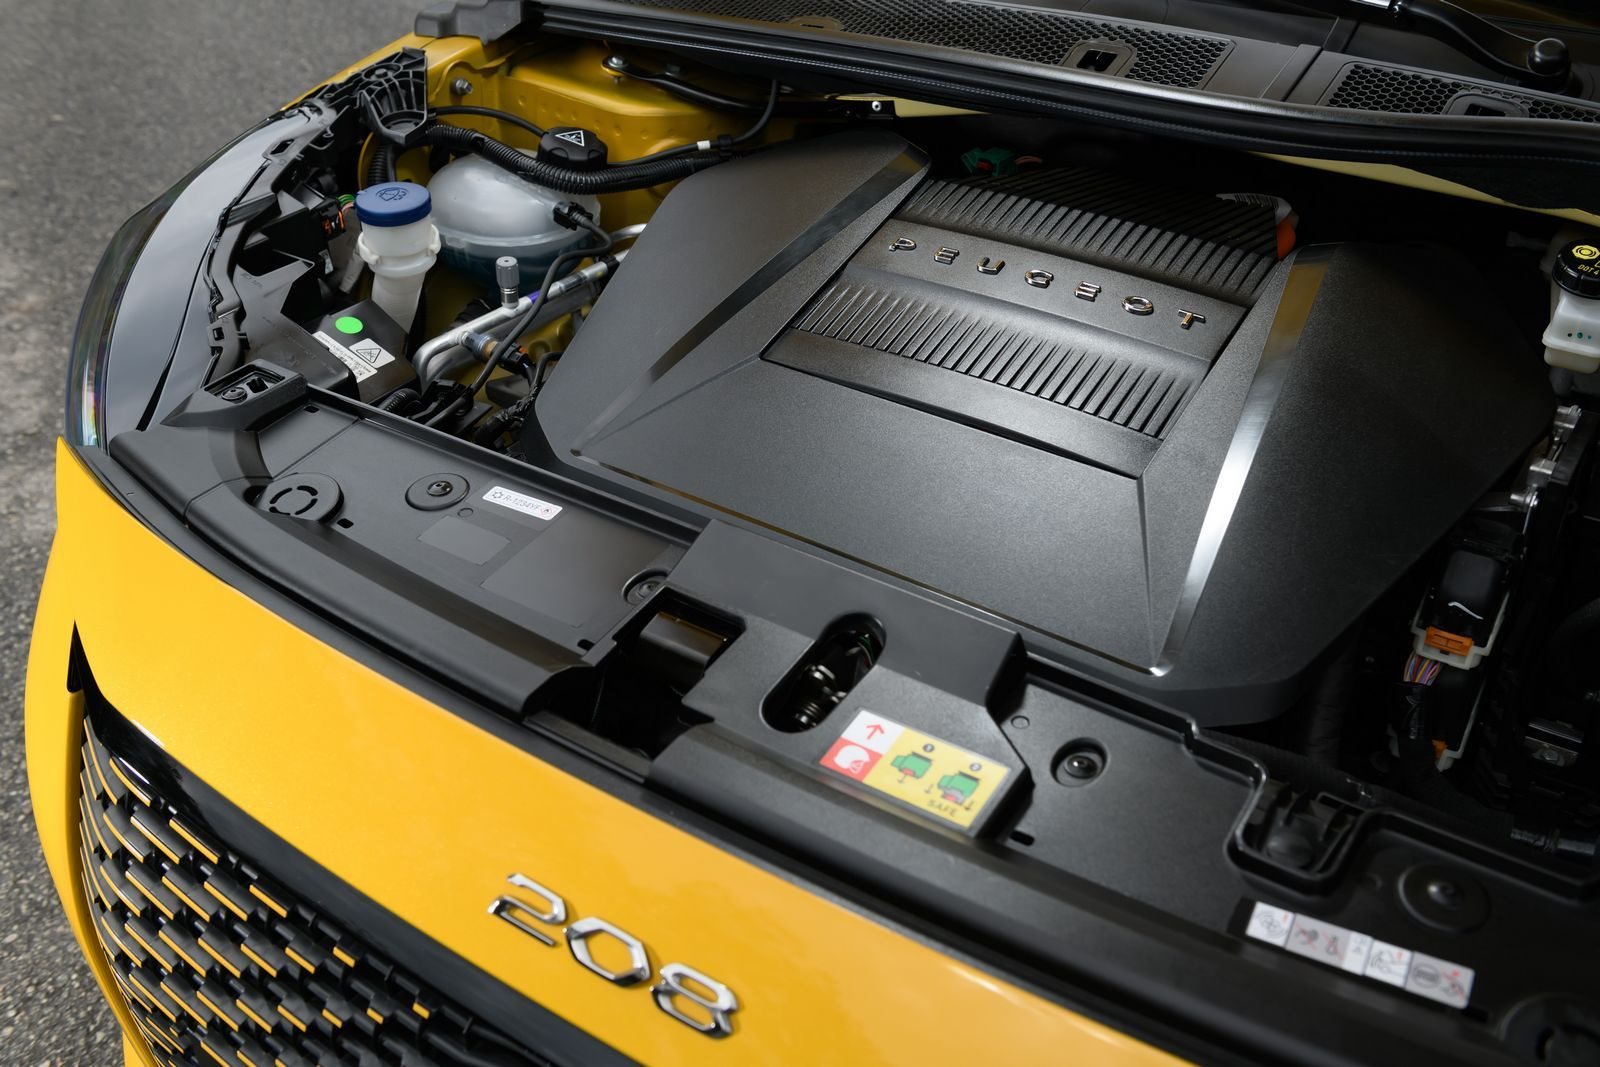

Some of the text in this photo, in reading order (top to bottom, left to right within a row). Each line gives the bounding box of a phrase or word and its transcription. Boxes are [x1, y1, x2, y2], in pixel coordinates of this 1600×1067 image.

[888, 237, 1206, 330] PEUGEOT
[1577, 264, 1595, 273] DOT
[927, 799, 958, 818] SAFE
[487, 873, 739, 1040] 208
